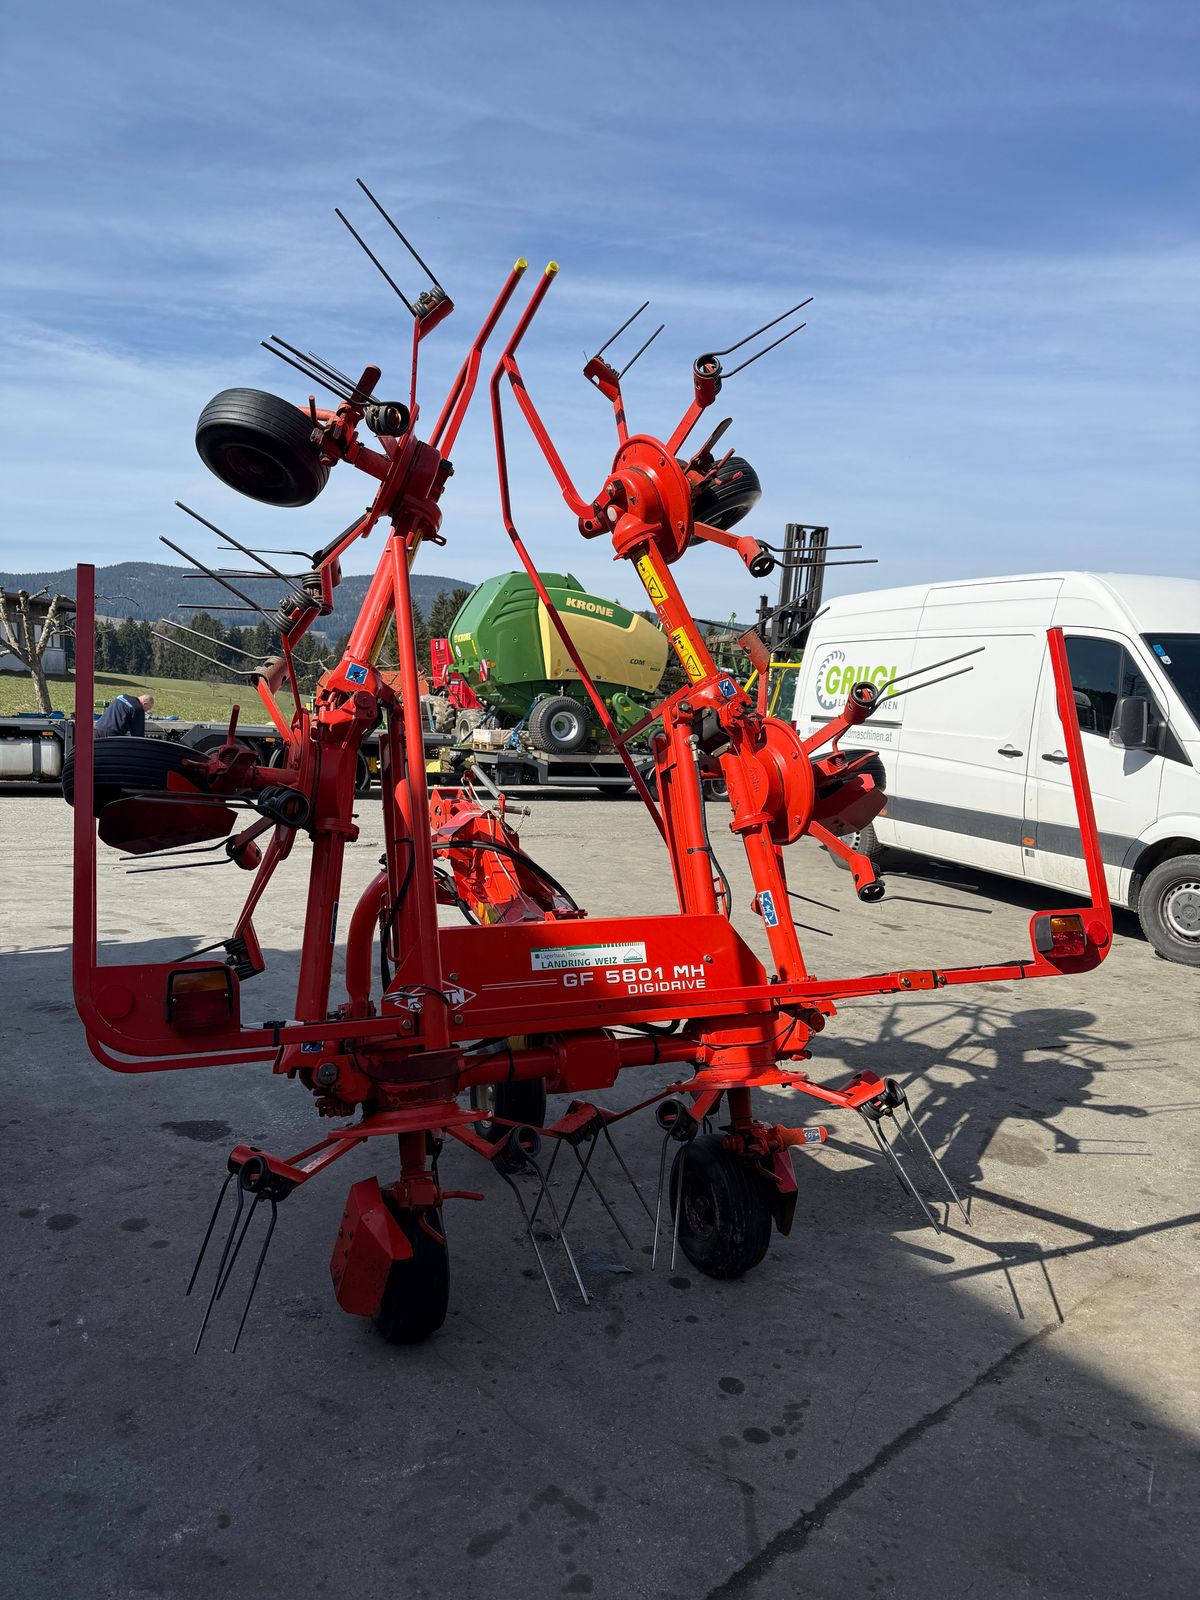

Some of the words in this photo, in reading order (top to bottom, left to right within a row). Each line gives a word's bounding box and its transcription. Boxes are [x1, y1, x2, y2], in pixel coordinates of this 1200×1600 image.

[566, 597, 614, 618] KRONE
[825, 665, 900, 696] GAUGL
[541, 958, 591, 969] LANDRING
[594, 957, 618, 965] WEIZ
[563, 971, 594, 988] GF
[605, 966, 664, 984] 5801
[673, 964, 705, 979] MH
[628, 979, 706, 995] DIGIDRIVE
